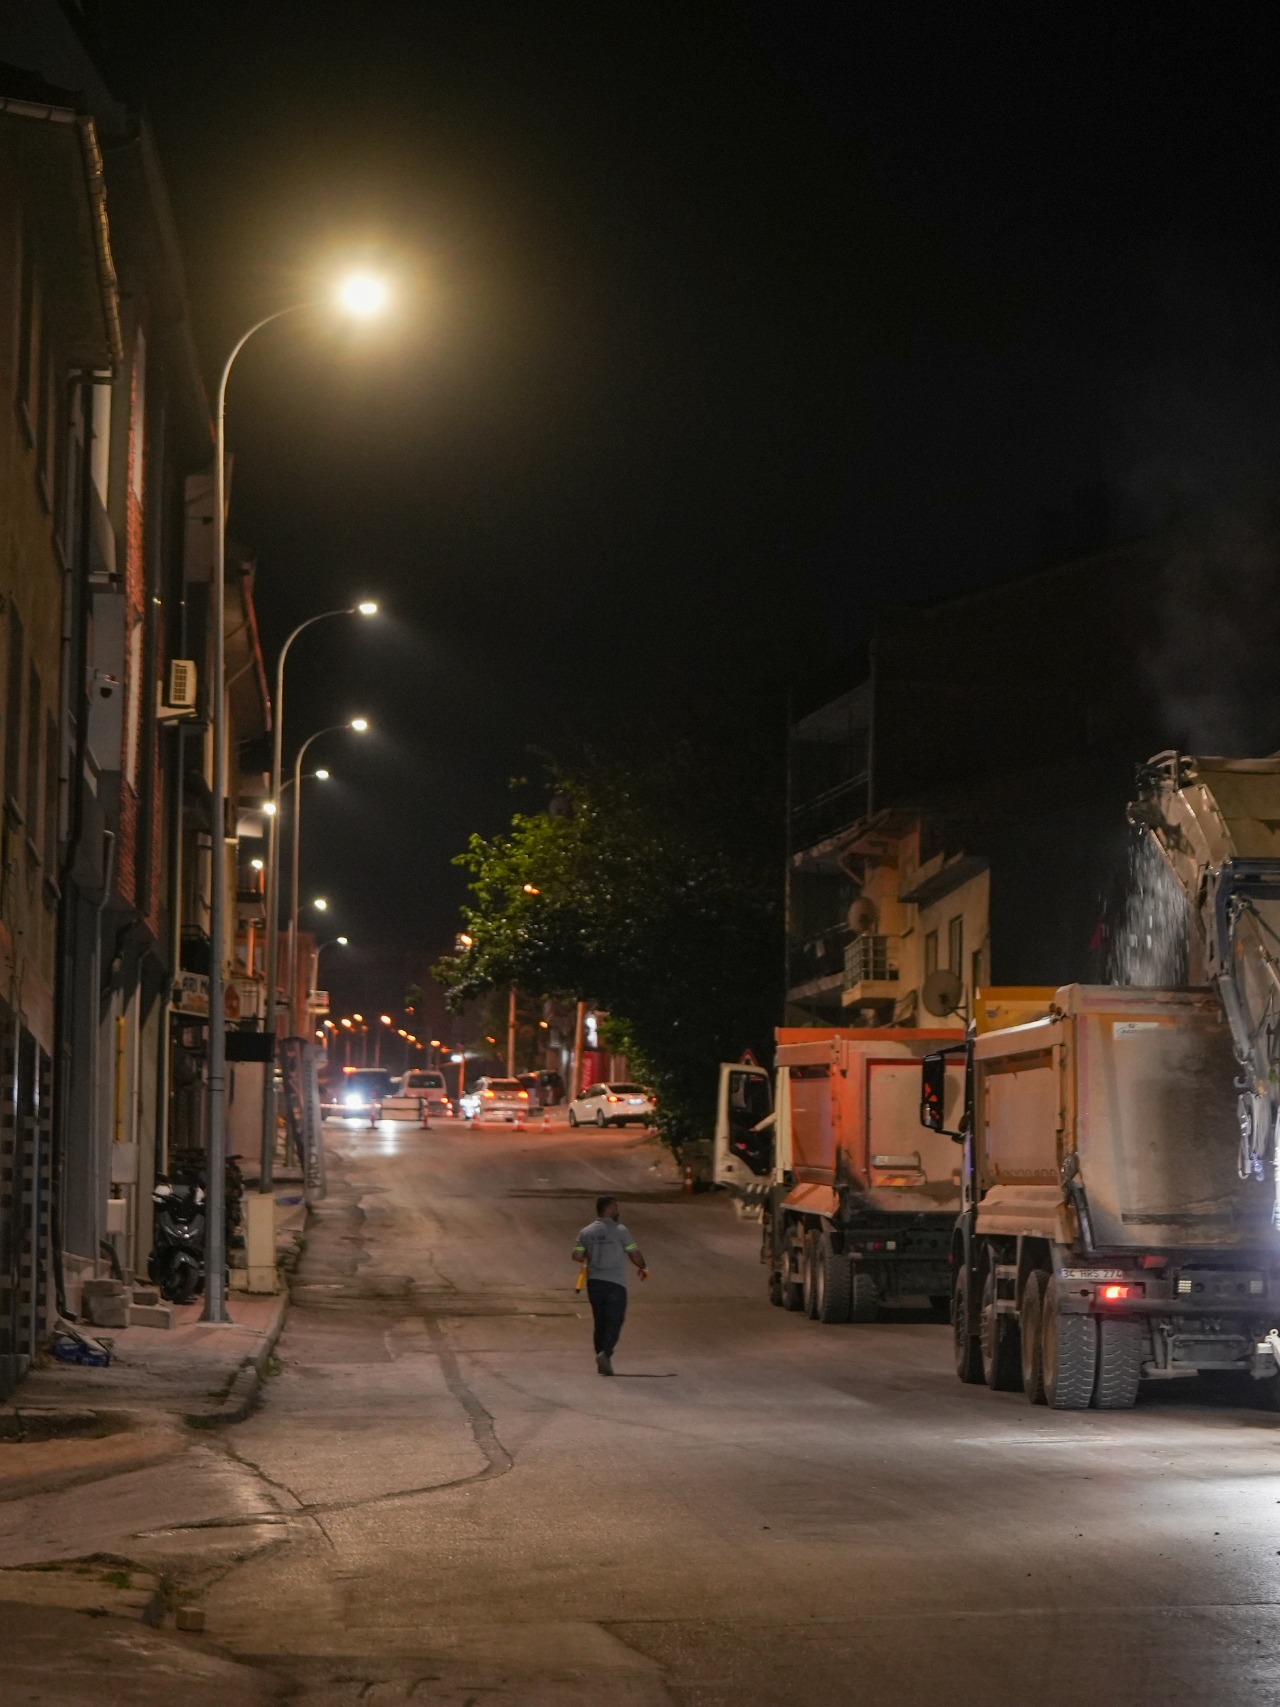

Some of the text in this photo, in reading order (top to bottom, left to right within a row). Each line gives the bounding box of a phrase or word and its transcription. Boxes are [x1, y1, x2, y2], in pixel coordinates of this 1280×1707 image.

[1063, 1269, 1122, 1278] 34 HRS 274
